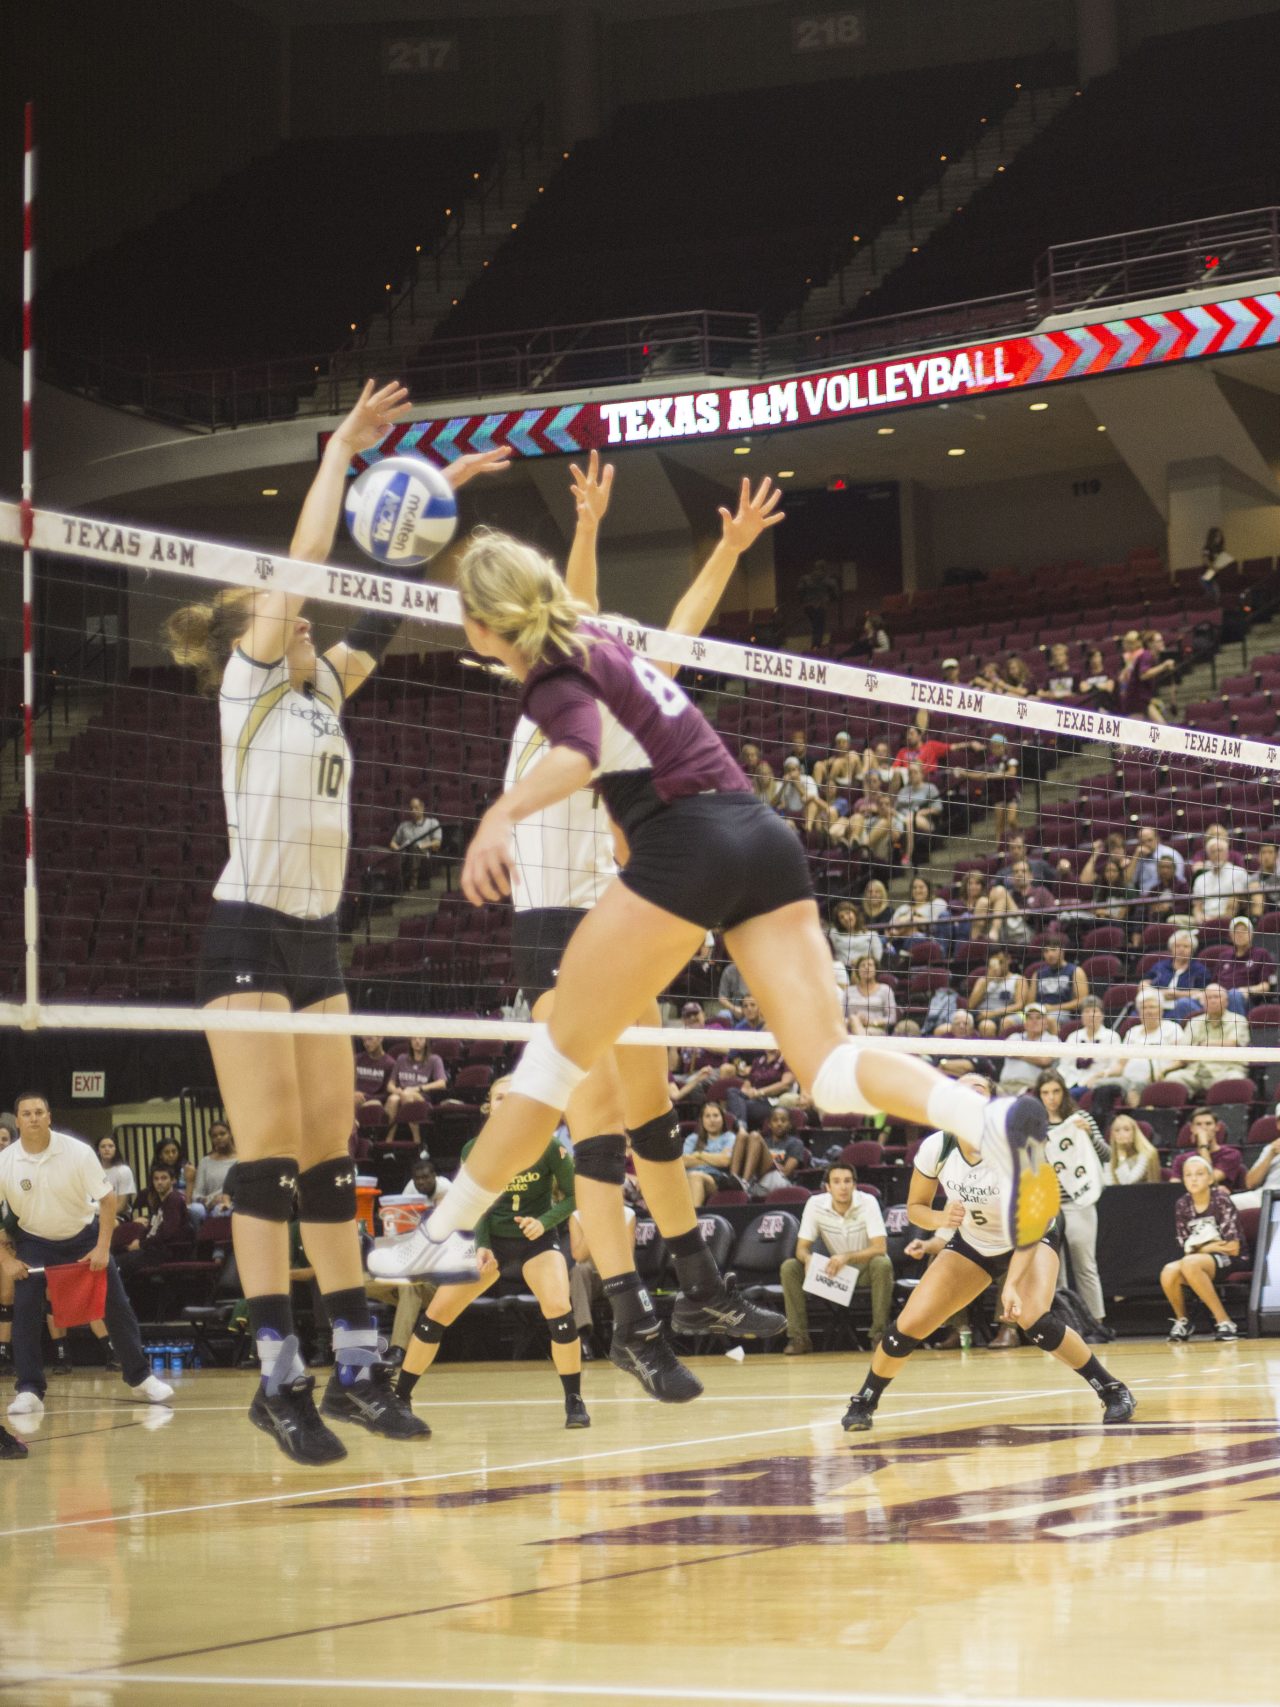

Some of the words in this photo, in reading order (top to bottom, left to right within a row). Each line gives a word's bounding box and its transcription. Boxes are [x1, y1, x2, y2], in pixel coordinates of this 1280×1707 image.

[799, 15, 861, 47] 218
[387, 41, 452, 71] 217
[600, 392, 720, 443] TEXAS
[728, 381, 799, 431] A&M
[802, 347, 1015, 417] VOLLEYBALL
[393, 494, 421, 551] molten
[62, 518, 140, 557] TEXAS
[150, 538, 195, 568] A&M
[327, 570, 393, 603] TEXAS
[401, 583, 439, 615] A&M
[745, 651, 793, 678] TEXAS
[798, 661, 827, 685] A&M
[910, 681, 953, 710] TEXAS
[957, 692, 983, 714] A&M
[310, 713, 346, 738] Sta
[1057, 709, 1094, 734] TEXAS
[1098, 715, 1121, 738] A&M
[1184, 732, 1218, 755] TEXAS
[1221, 739, 1241, 759] A&M
[317, 751, 344, 798] 10
[74, 1075, 102, 1092] EXIT
[512, 1194, 520, 1212] 1
[946, 1180, 1001, 1197] Colorado
[959, 1192, 989, 1206] State
[970, 1210, 988, 1226] 5
